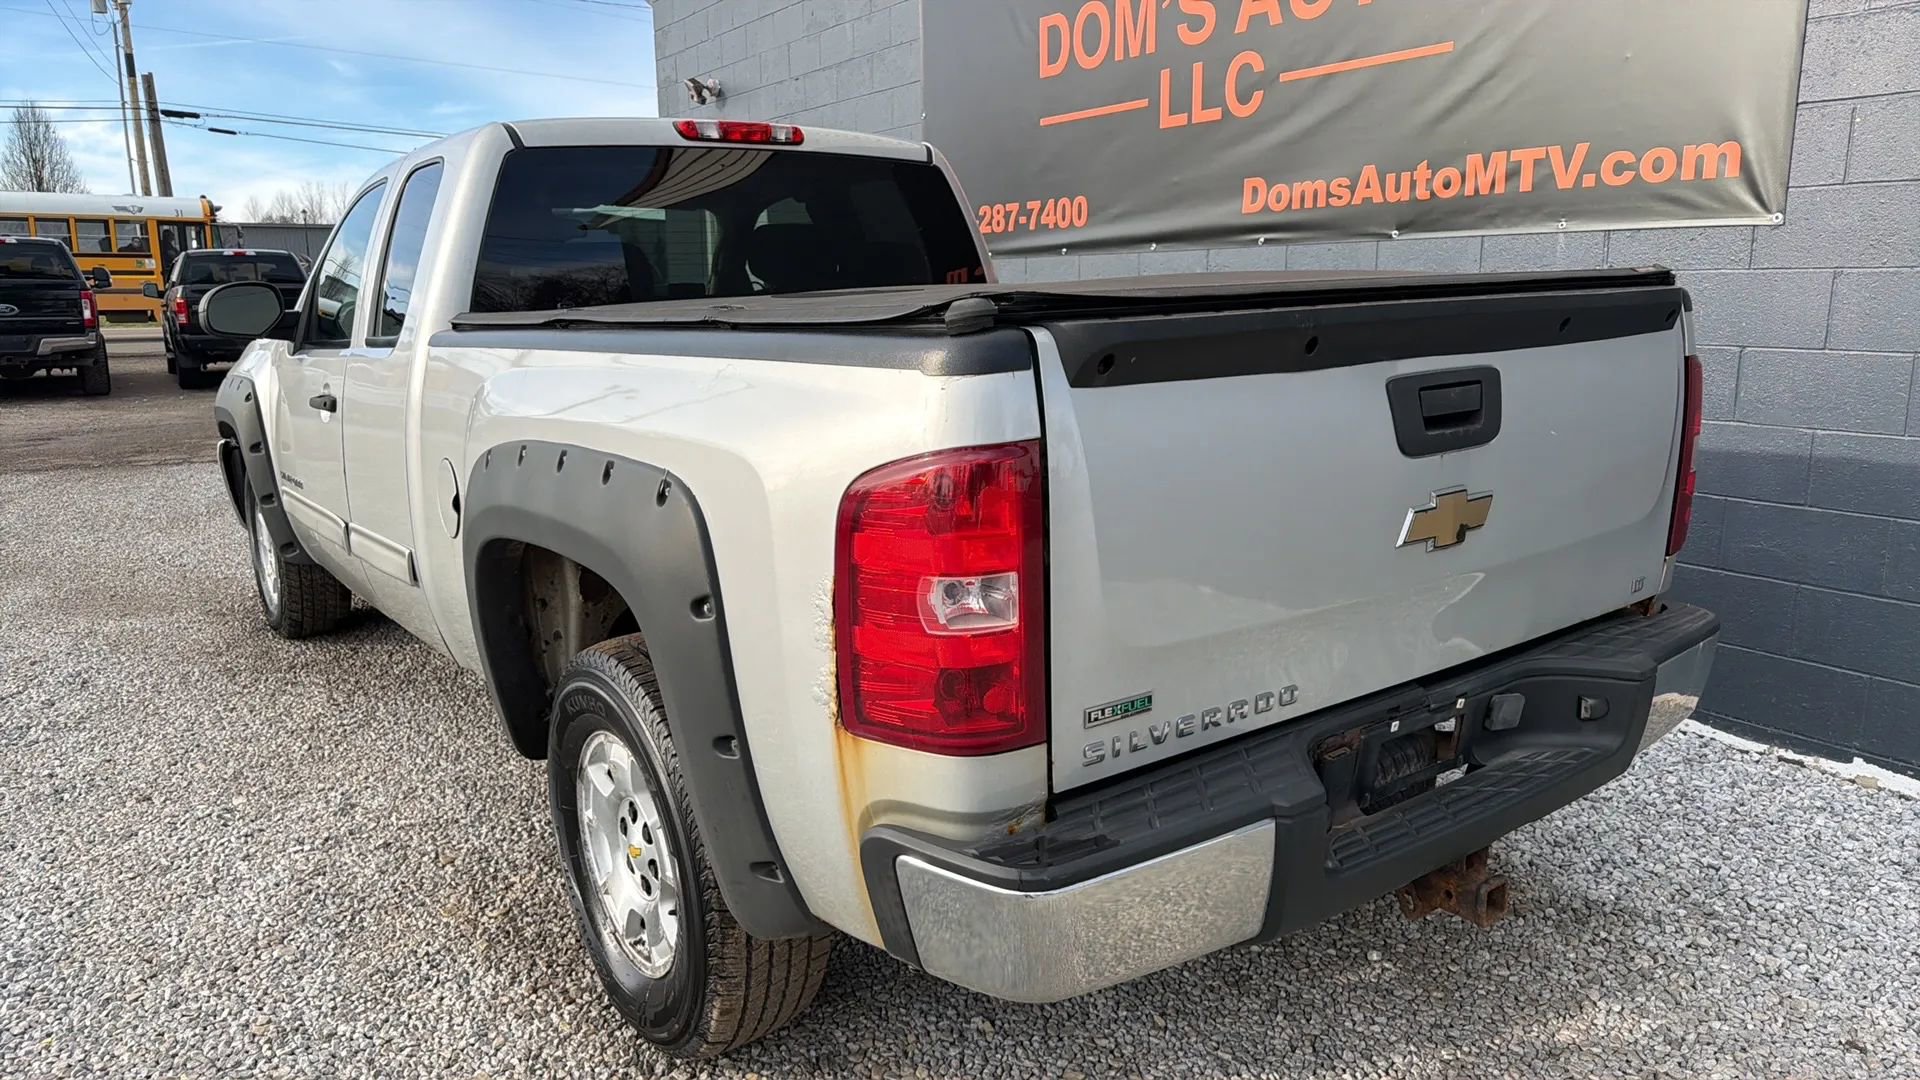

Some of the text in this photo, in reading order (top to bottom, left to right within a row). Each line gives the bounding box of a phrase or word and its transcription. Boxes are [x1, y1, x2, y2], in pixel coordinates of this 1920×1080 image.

[1159, 50, 1265, 129] LLC
[1242, 139, 1742, 215] DomsAutoMTV.com
[1082, 684, 1299, 767] SILVERADO
[1090, 697, 1151, 722] FLEXFUEL
